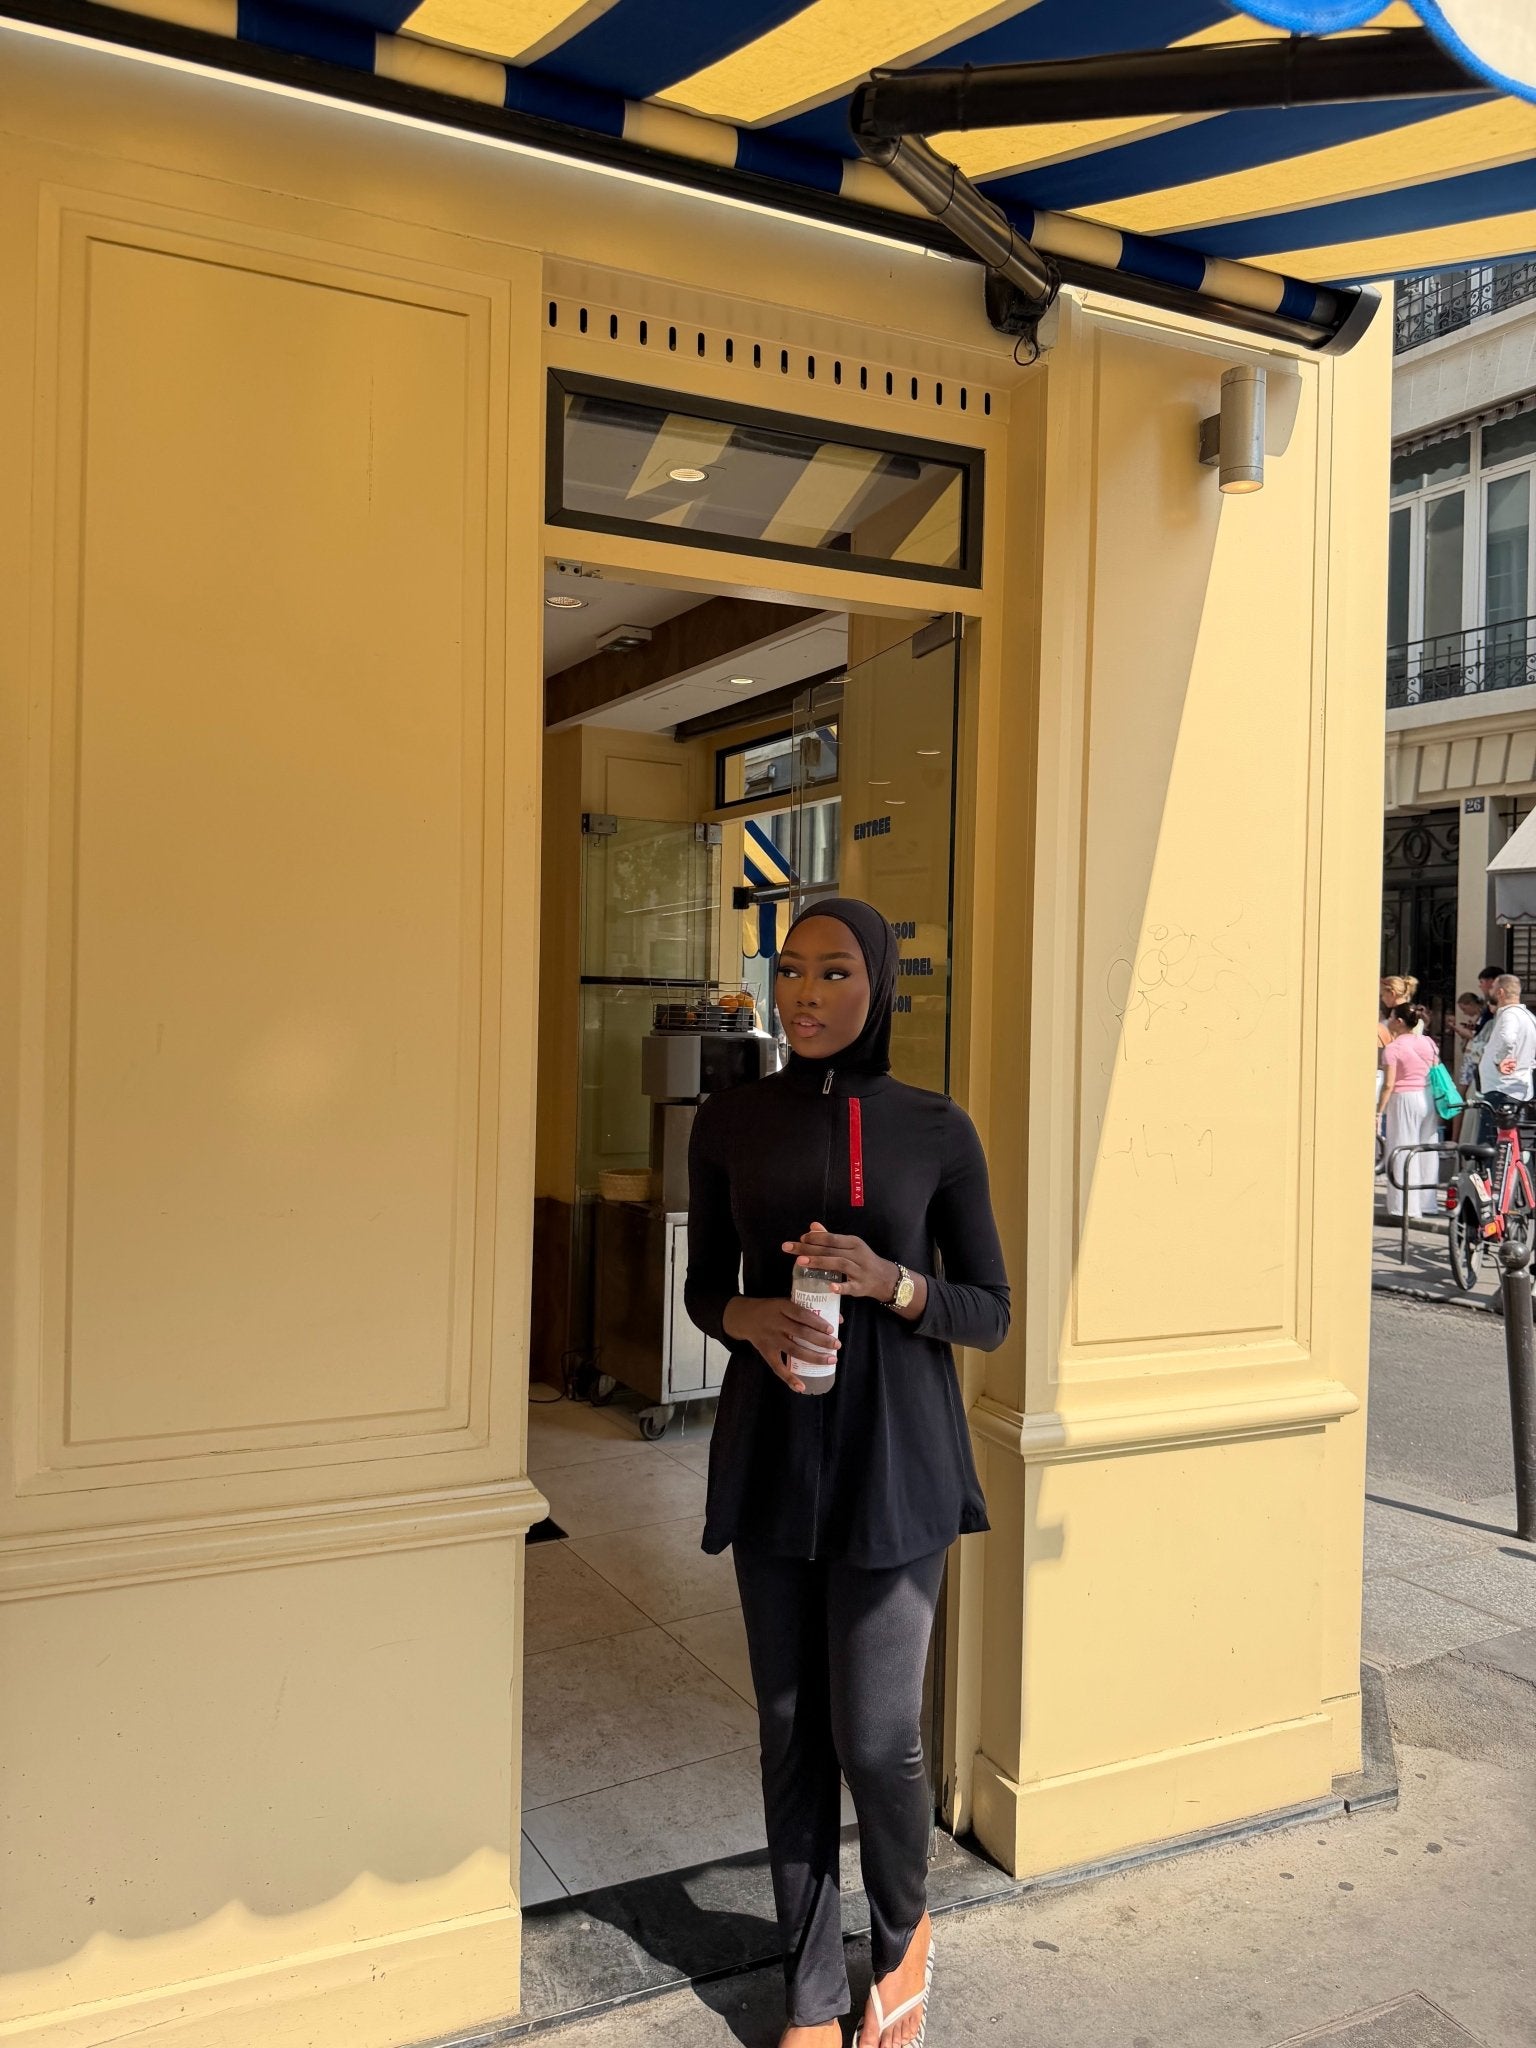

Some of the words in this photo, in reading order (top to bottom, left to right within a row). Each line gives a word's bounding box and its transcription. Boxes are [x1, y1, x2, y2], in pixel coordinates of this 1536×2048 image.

[1465, 799, 1481, 811] 26
[853, 815, 891, 840] ENTREE
[897, 957, 934, 976] TUREL
[854, 1161, 862, 1200] TAHIRA
[796, 1292, 828, 1303] VITAMIN
